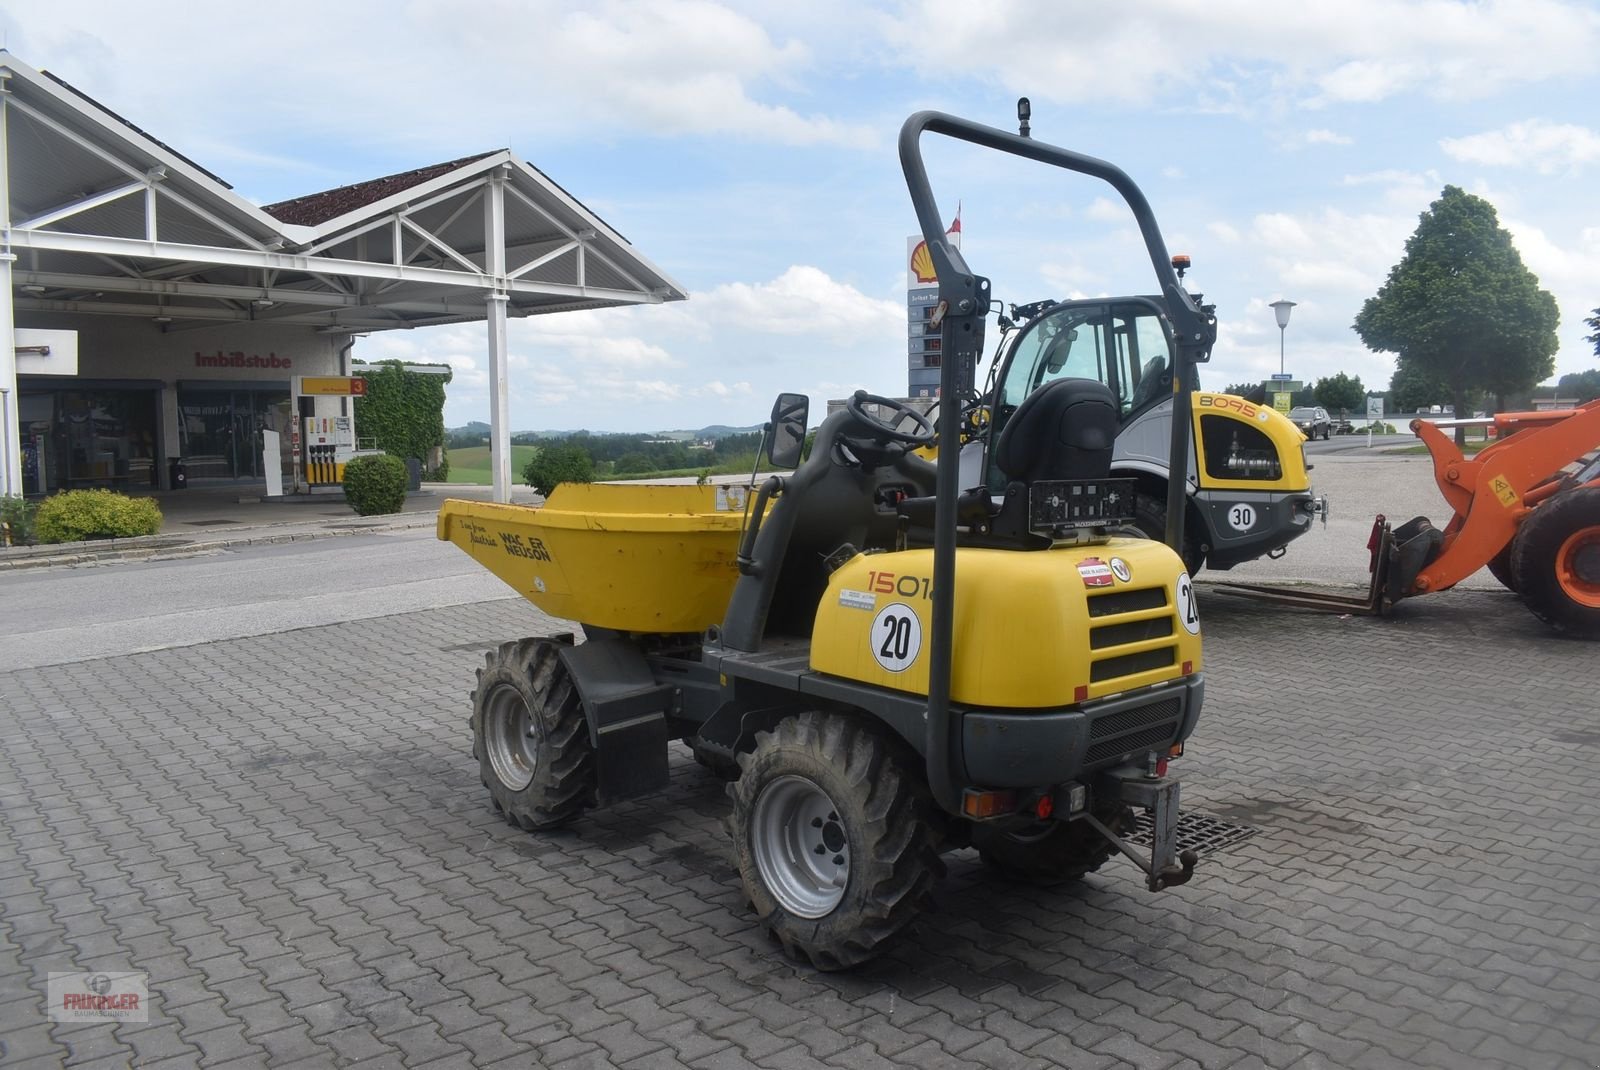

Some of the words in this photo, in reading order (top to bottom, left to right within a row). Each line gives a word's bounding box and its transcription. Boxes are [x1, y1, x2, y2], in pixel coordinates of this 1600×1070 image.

[195, 351, 292, 368] Imbißstube
[354, 380, 363, 392] 3
[1200, 396, 1256, 418] 8095
[1233, 508, 1250, 526] 30
[504, 543, 551, 562] NEUSON
[881, 614, 912, 660] 20
